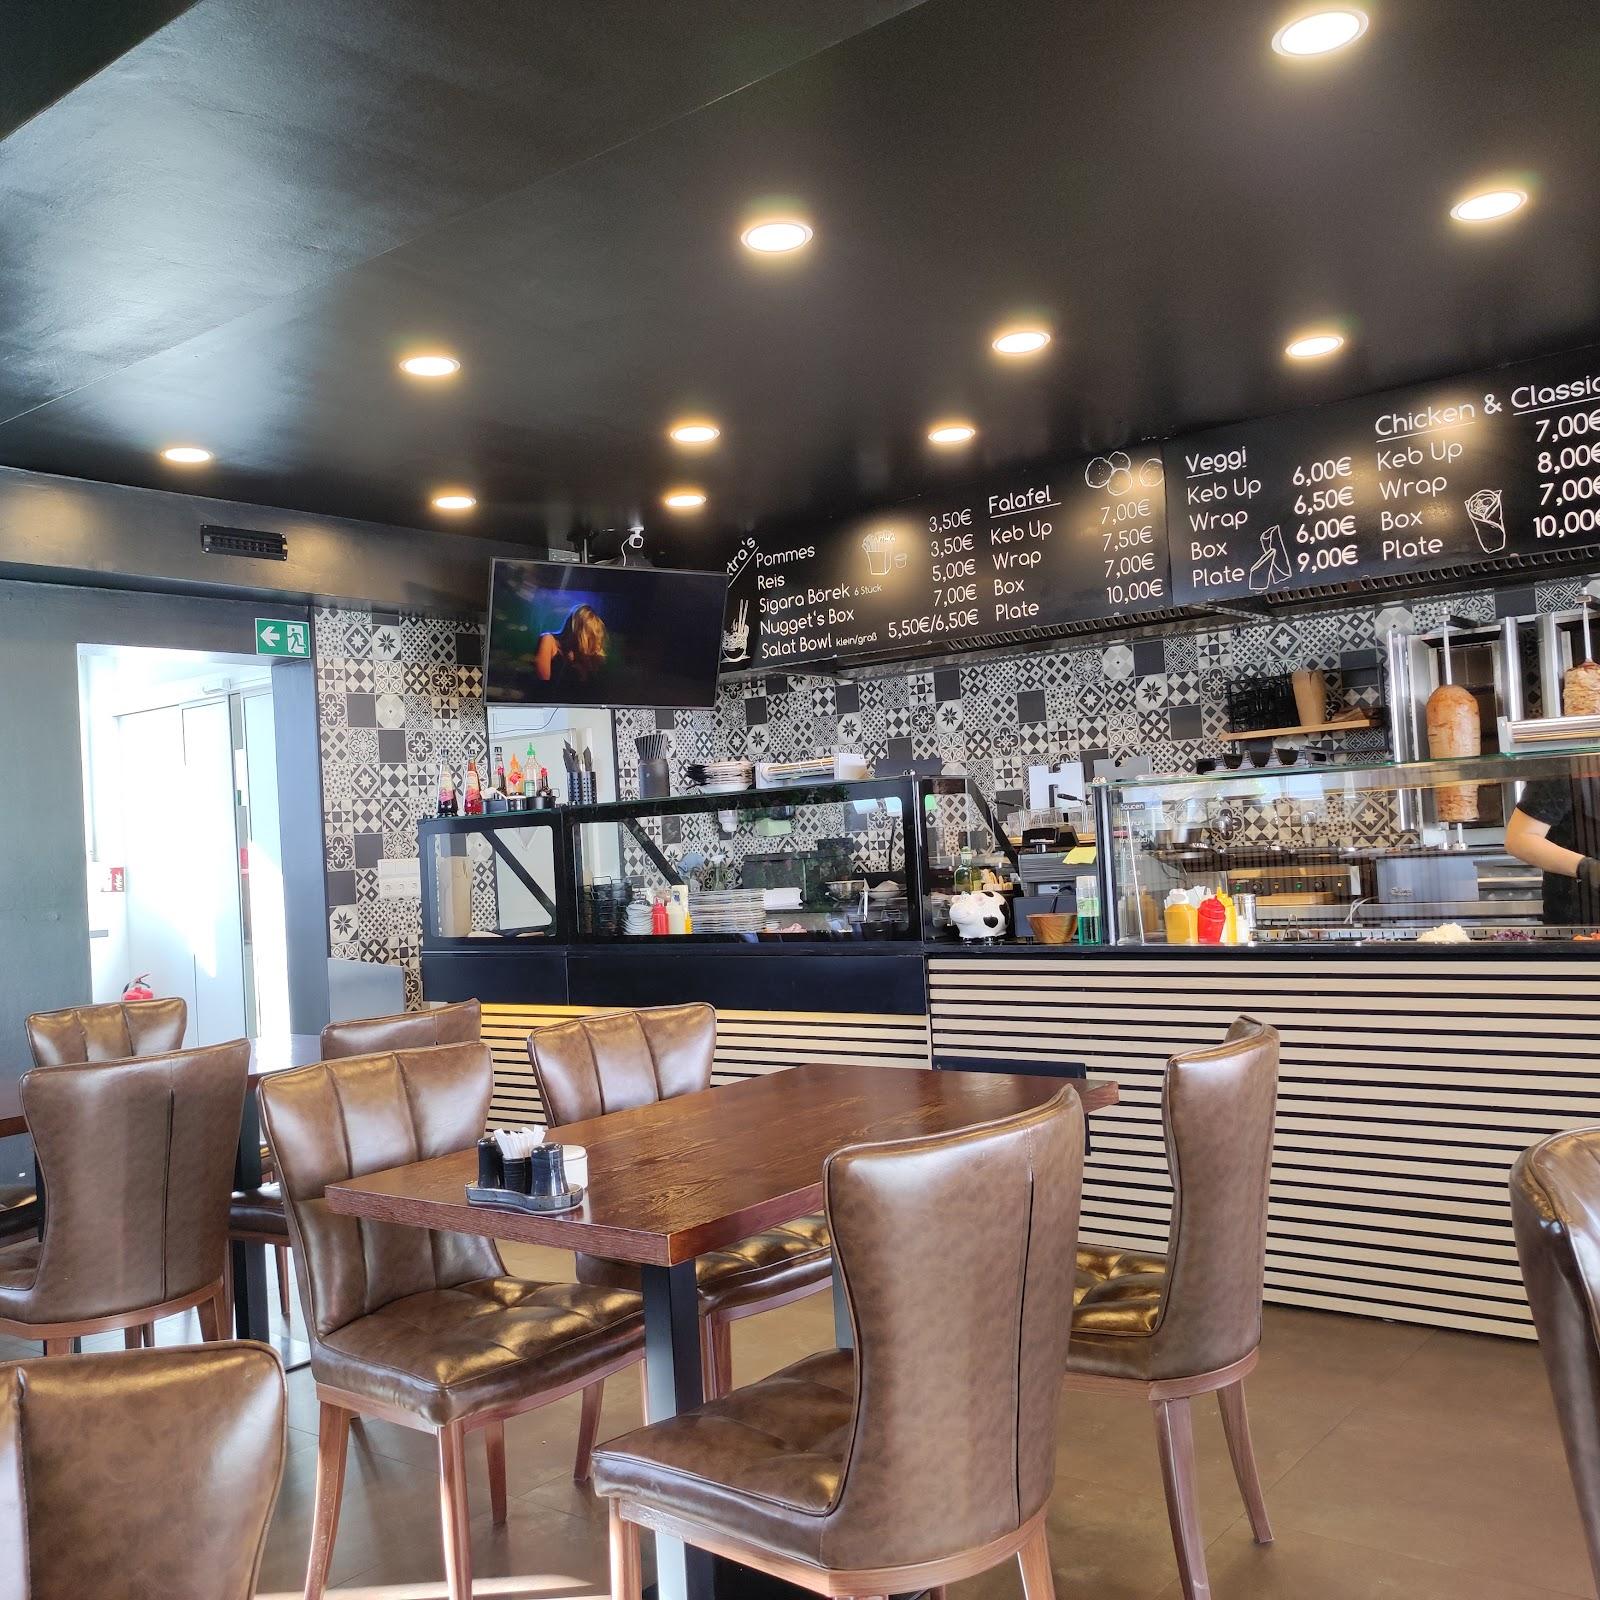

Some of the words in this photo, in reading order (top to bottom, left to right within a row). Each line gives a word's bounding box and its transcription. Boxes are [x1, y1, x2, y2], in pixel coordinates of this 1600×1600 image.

[1375, 402, 1475, 436] Chicken
[1484, 393, 1503, 415] &
[1185, 446, 1247, 474] Veggi
[1377, 448, 1424, 471] Keb
[1429, 441, 1463, 464] Up
[1292, 456, 1353, 486] 6,00€
[988, 485, 1052, 515] Falafel
[1187, 482, 1227, 505] Keb
[1233, 477, 1262, 500] Up
[1379, 475, 1448, 500] Wrap
[1101, 498, 1152, 525] 7,00€
[1294, 486, 1355, 515] 6,50€
[928, 508, 973, 533] 3,50€
[990, 523, 1024, 545] Keb
[1027, 520, 1053, 541] Up
[1189, 510, 1249, 532] Wrap
[1295, 514, 1357, 545] 6,00€
[1380, 511, 1424, 531] Box
[930, 533, 975, 558] 3,50€
[1102, 525, 1154, 552] 7,50€
[1191, 542, 1228, 560] Box
[1383, 535, 1444, 560] Plate
[726, 536, 757, 576] tra's
[756, 545, 816, 568] Pommes
[992, 550, 1042, 571] Wrap
[1104, 552, 1156, 578] 7,00€
[1297, 545, 1359, 574] 9,00€
[757, 572, 786, 590] Reis
[932, 559, 977, 583] 5,00€
[1193, 565, 1246, 588] Plate
[759, 593, 804, 614] Sigara
[806, 583, 851, 606] Börek
[933, 584, 978, 609] 7,00€
[994, 579, 1025, 597] Box
[1106, 578, 1164, 606] 10,00€
[829, 607, 855, 625] Box
[888, 608, 980, 640] 5,50€/6,50€
[995, 601, 1040, 622] Plate
[761, 636, 798, 659] Salat
[800, 632, 833, 654] Bowl
[1120, 803, 1145, 812] Saucen
